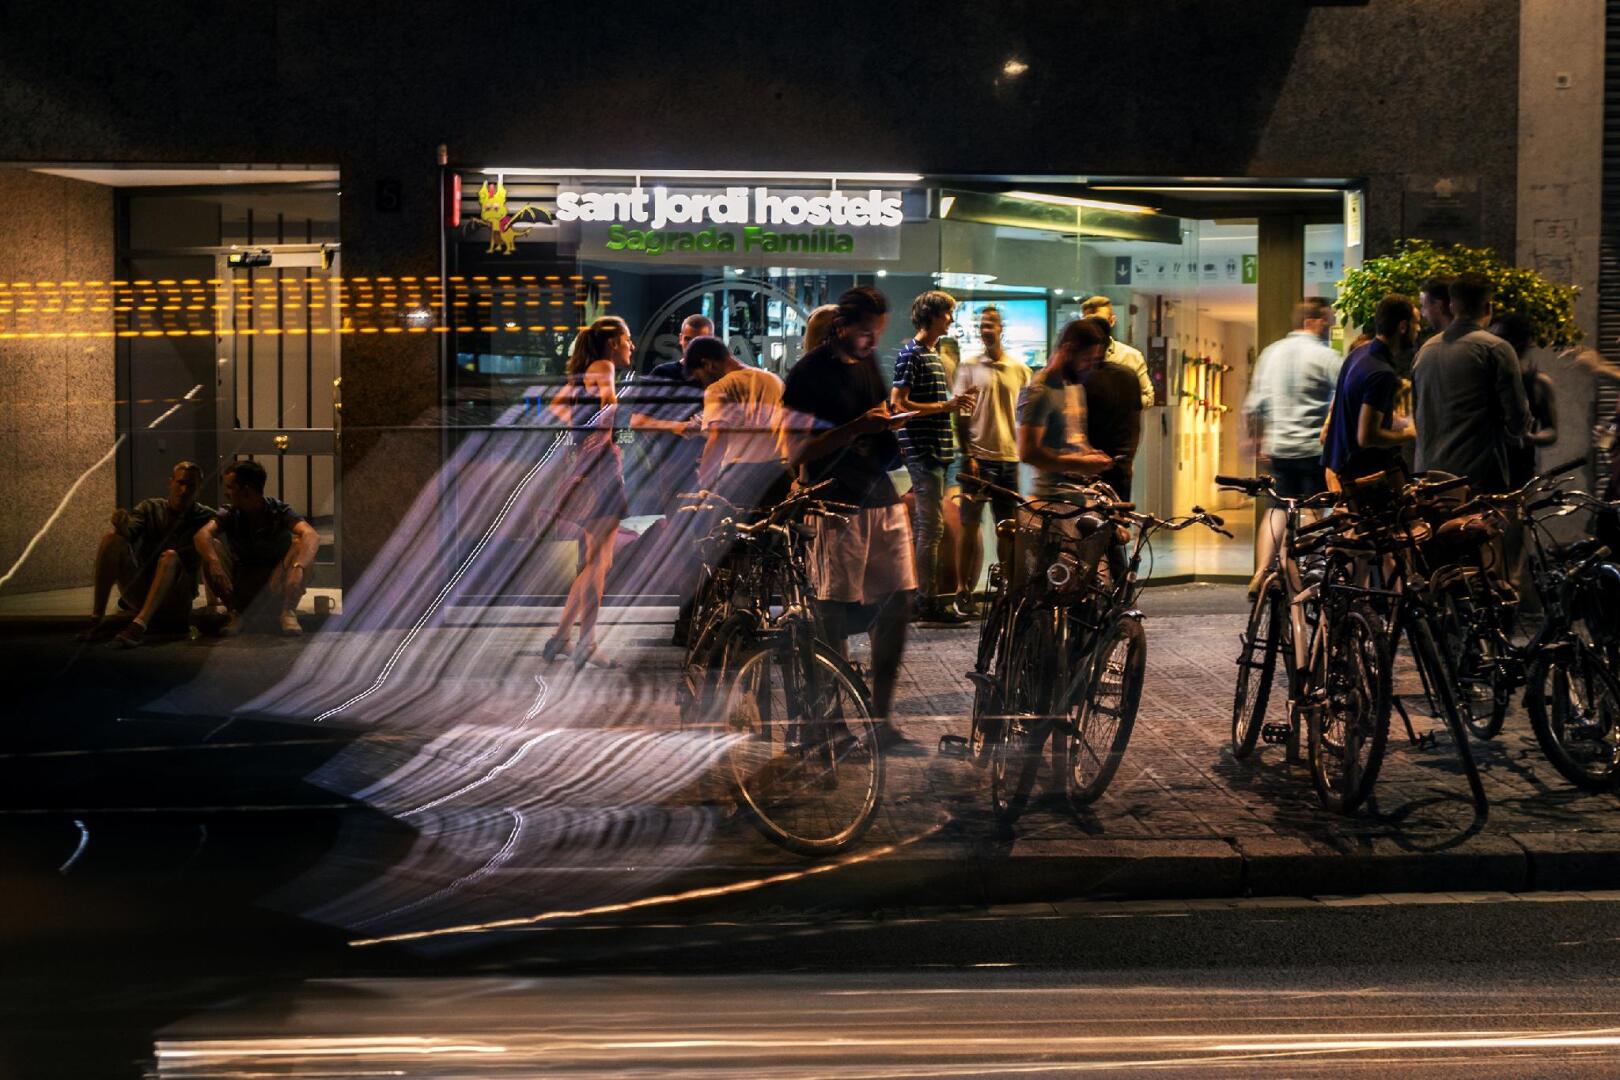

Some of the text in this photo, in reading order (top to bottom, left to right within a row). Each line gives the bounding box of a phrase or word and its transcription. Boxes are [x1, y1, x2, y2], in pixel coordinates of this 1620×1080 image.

[556, 187, 648, 222] sant
[755, 187, 903, 227] hostels
[607, 224, 736, 255] Sagrada
